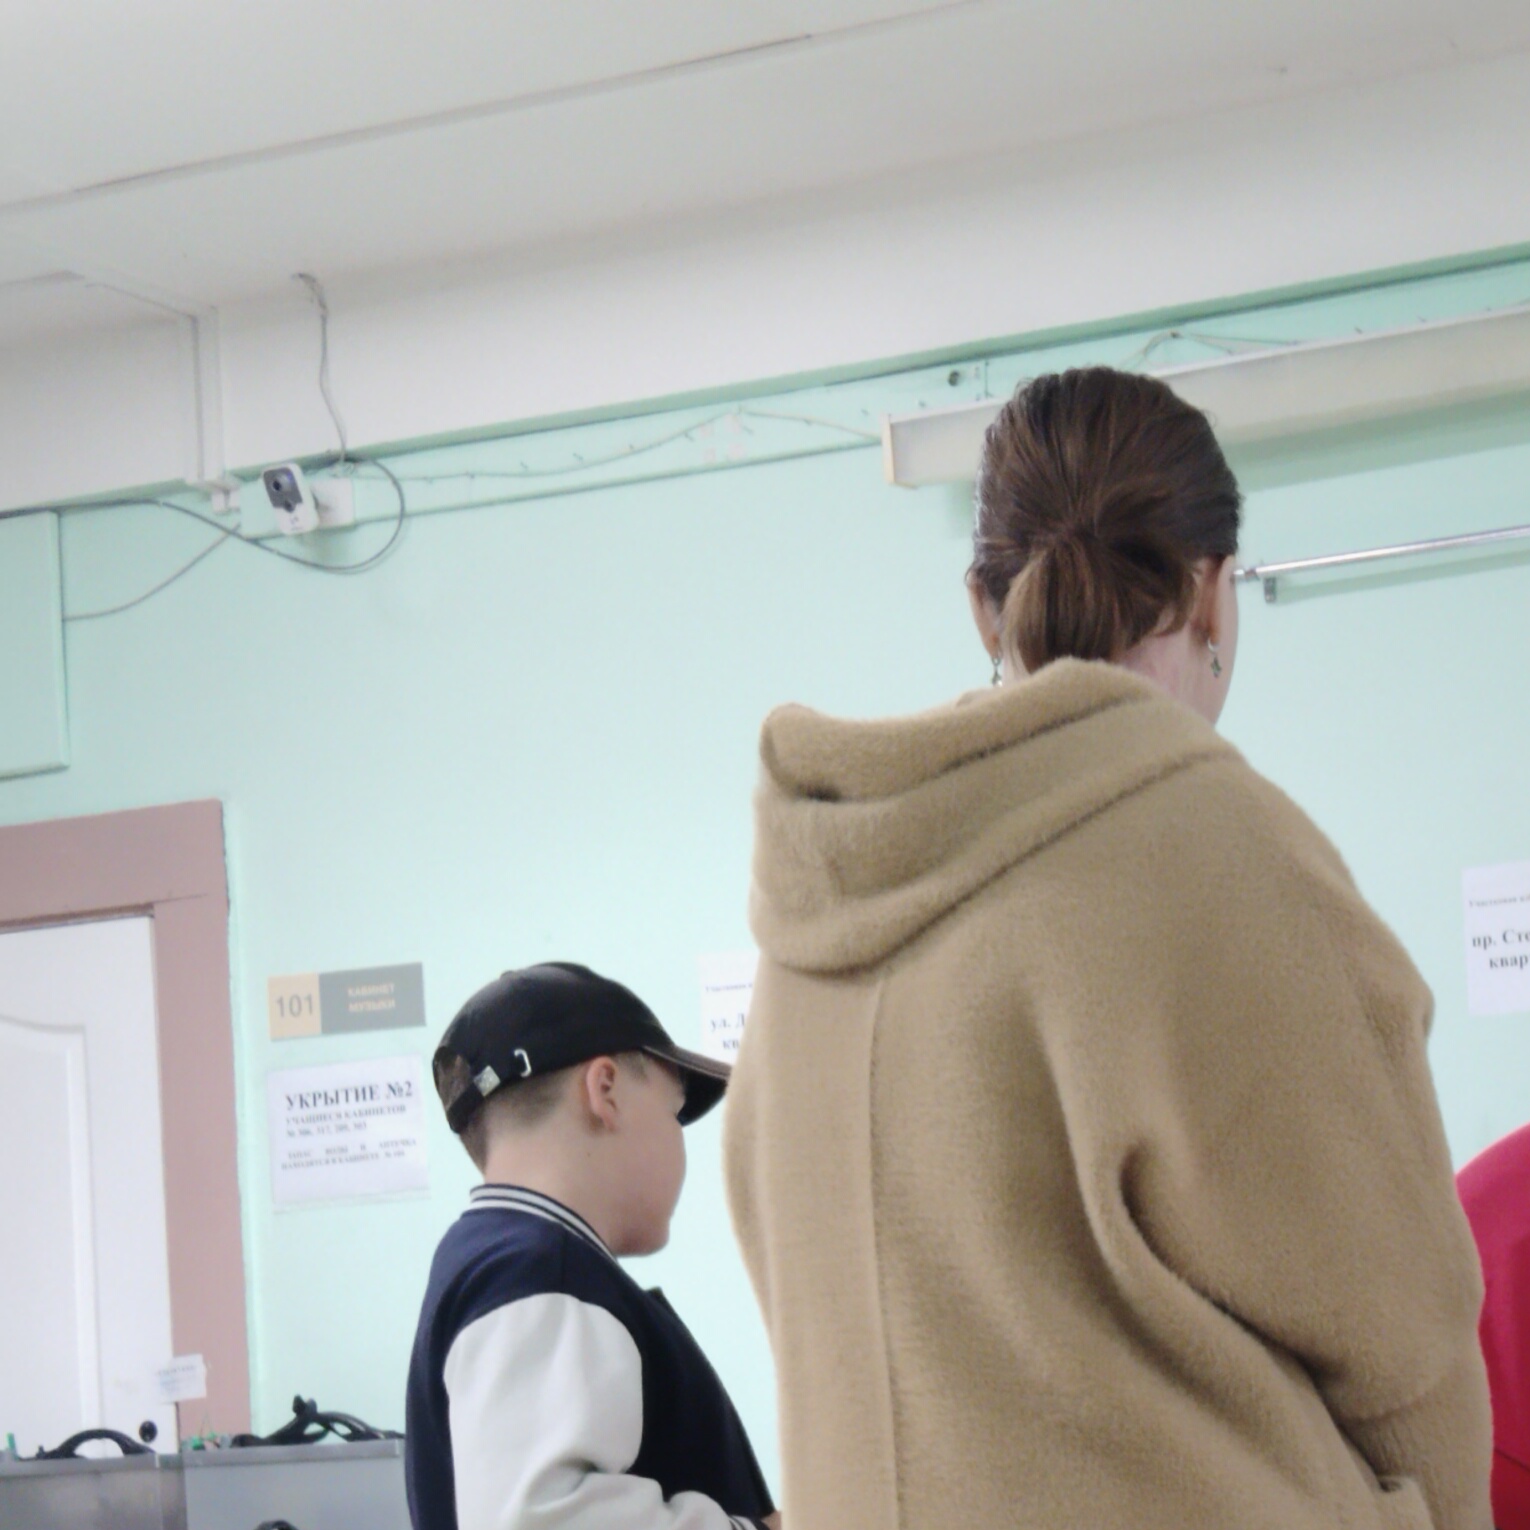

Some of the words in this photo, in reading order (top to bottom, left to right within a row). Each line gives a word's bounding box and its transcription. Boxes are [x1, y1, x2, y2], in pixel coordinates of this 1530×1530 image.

[1472, 935, 1497, 951] пр.
[276, 993, 314, 1019] 101
[285, 1084, 380, 1111] УКРЫТИЕ
[385, 1080, 413, 1100] №2
